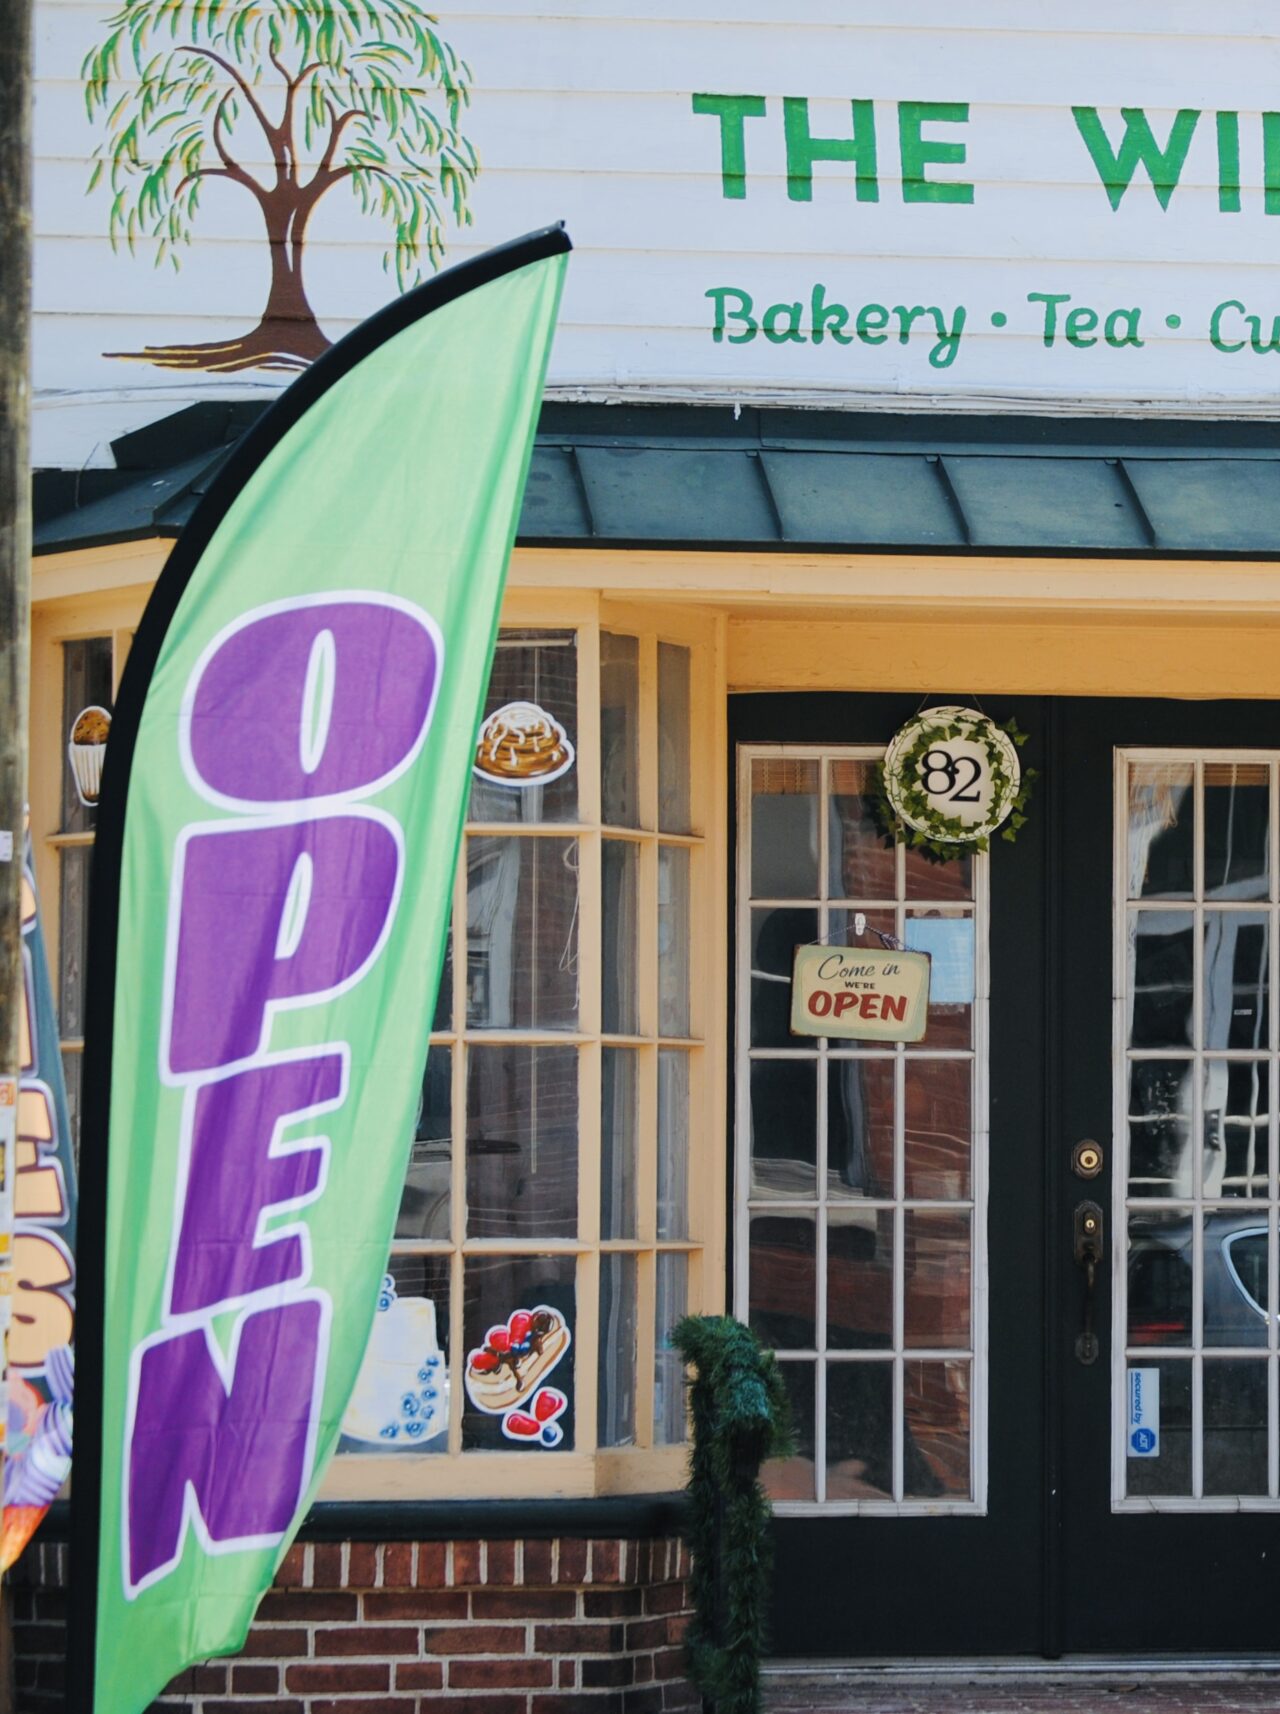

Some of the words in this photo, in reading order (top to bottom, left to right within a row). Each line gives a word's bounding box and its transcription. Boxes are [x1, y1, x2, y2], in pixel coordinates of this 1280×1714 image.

[691, 93, 975, 204] THE
[704, 283, 967, 369] Bakery
[1027, 292, 1144, 349] Tea
[921, 750, 981, 802] 82
[817, 953, 876, 980] Come
[882, 962, 901, 976] in
[844, 980, 876, 990] WE'RE
[808, 990, 907, 1022] OPEN
[122, 590, 444, 1601] OPEN
[1134, 1371, 1143, 1411] secured
[1133, 1410, 1143, 1424] by
[1139, 1431, 1149, 1450] ADT
